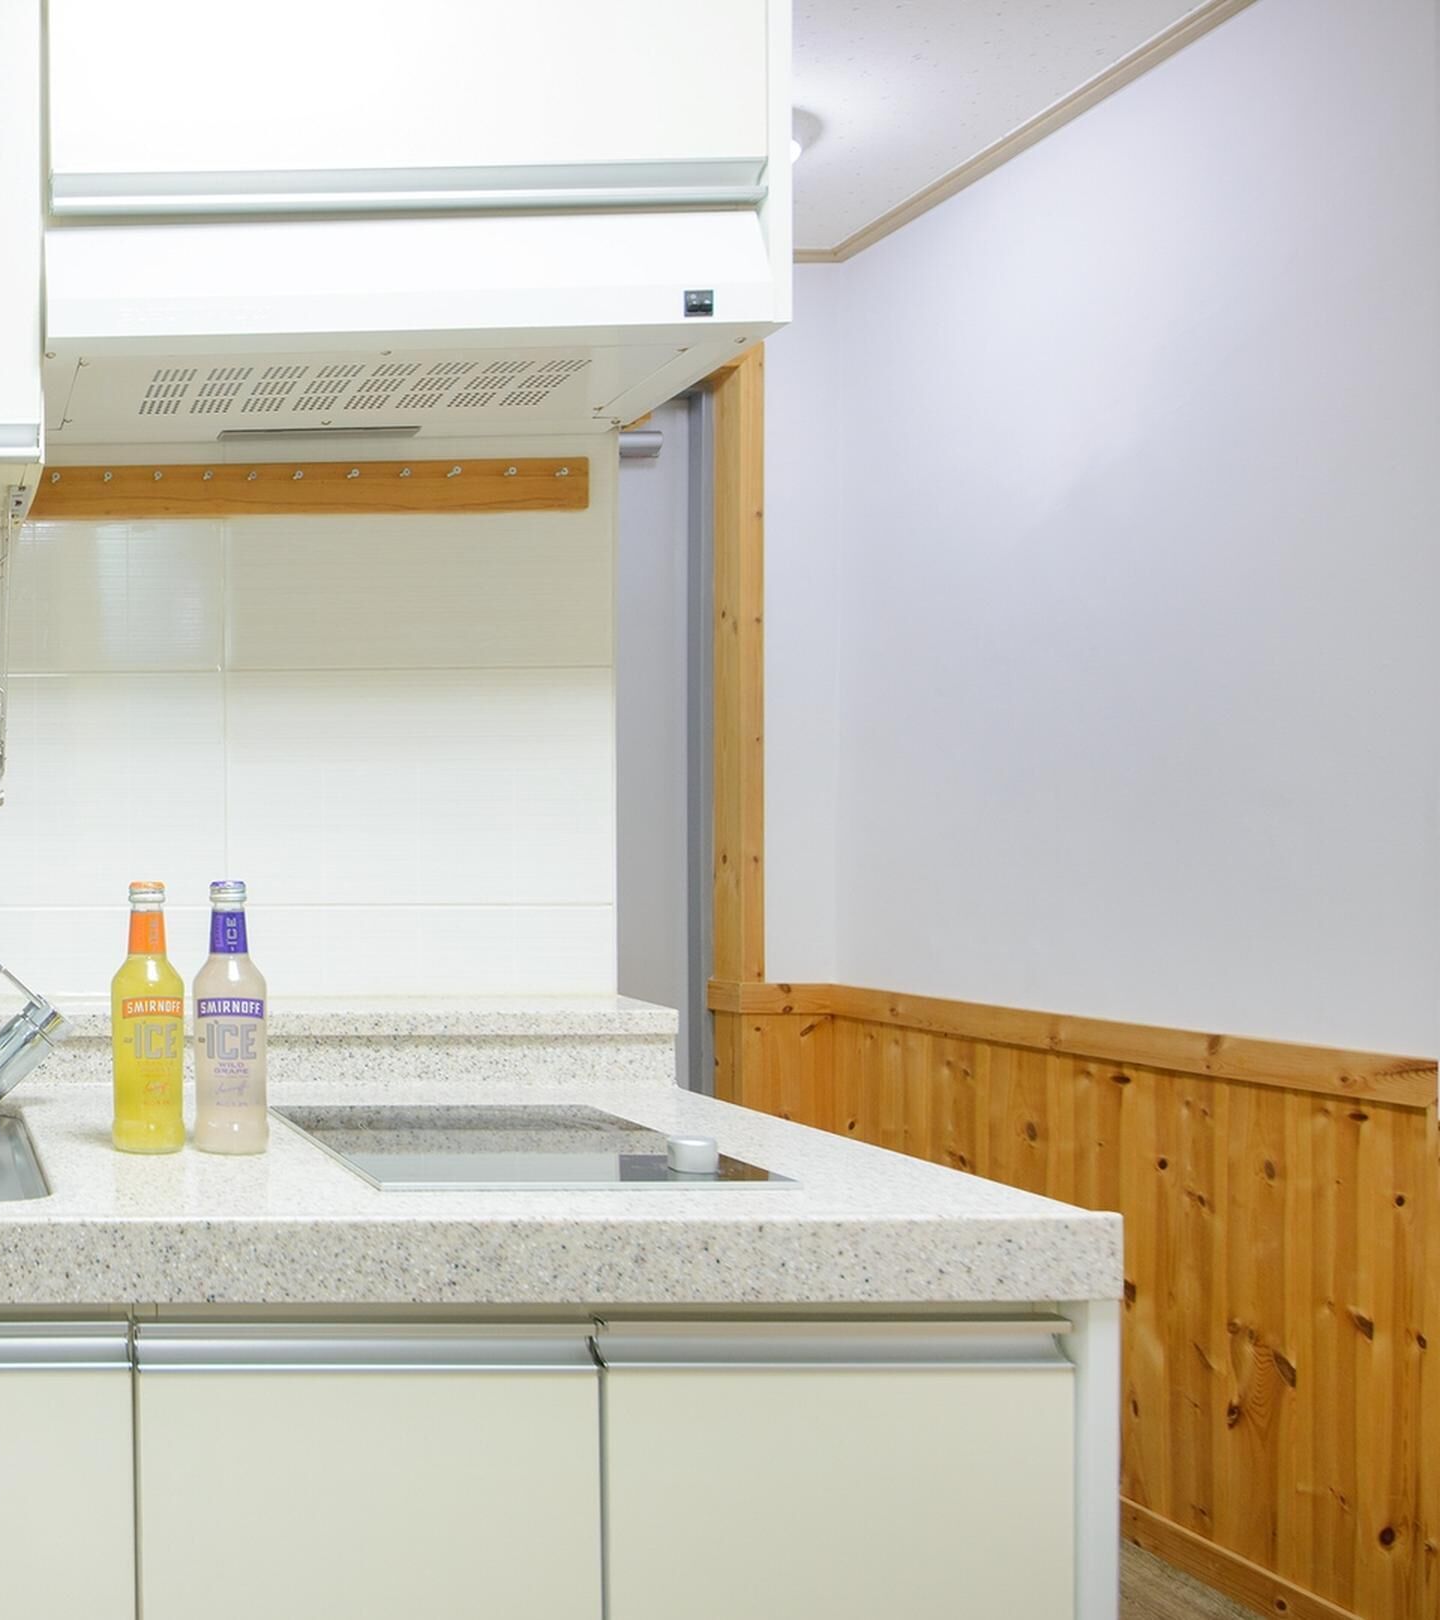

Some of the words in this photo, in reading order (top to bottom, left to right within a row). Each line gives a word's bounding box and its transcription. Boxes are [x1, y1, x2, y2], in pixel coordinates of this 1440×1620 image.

[226, 917, 238, 945] ICE
[127, 1000, 181, 1014] SMIRNOFF
[200, 1000, 261, 1015] SMIRNOFF
[134, 1023, 177, 1059] ICE
[206, 1023, 257, 1060] ICE
